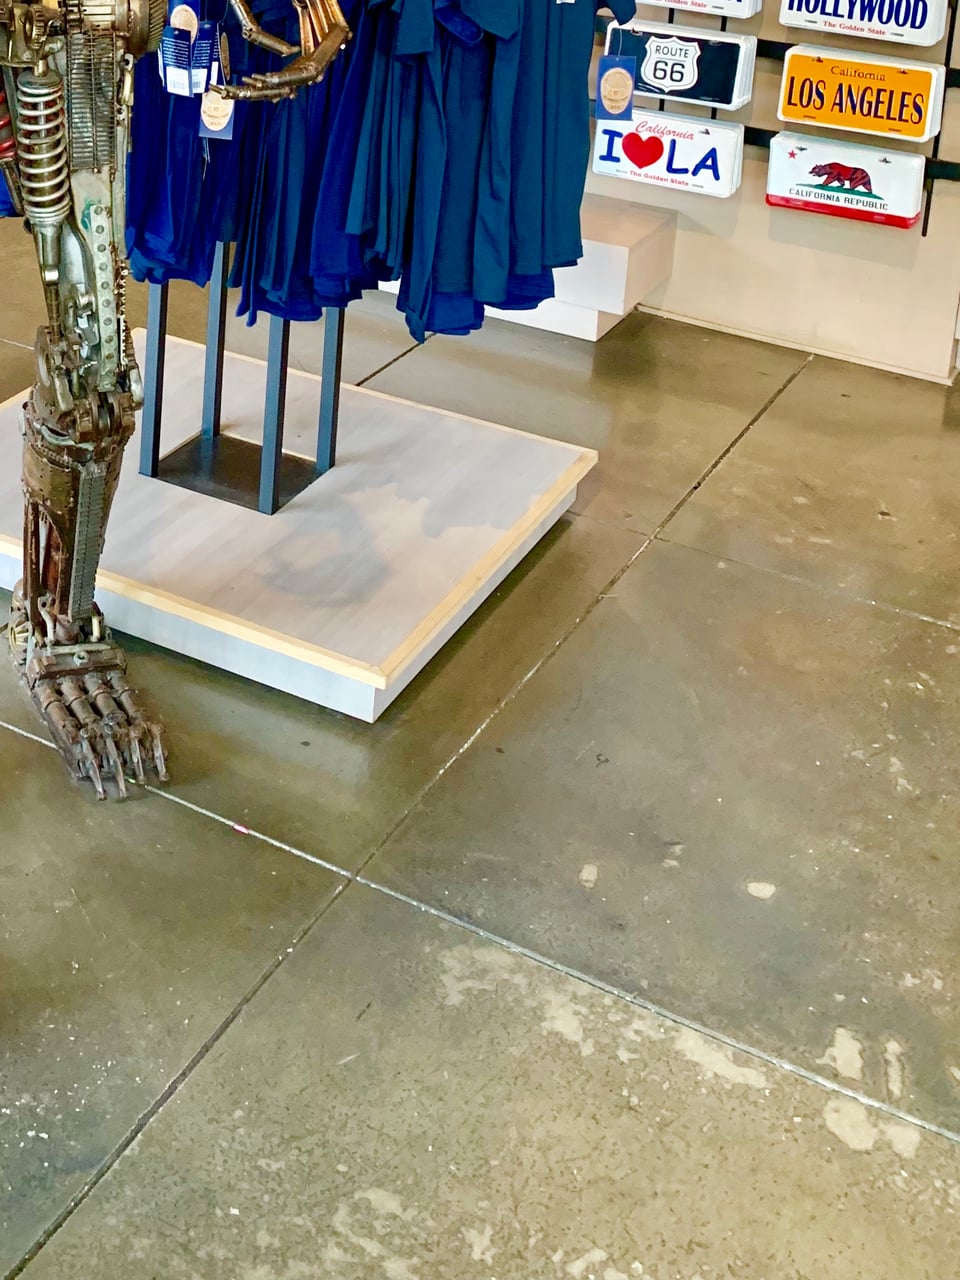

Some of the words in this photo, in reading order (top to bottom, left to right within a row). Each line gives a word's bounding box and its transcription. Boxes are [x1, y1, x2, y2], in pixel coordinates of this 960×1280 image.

[691, 0, 707, 8] State
[823, 20, 837, 28] The
[839, 23, 865, 34] Golden
[867, 26, 886, 36] State
[655, 45, 690, 58] ROUTE
[653, 61, 685, 82] 66
[830, 66, 886, 81] California
[787, 76, 826, 110] LOS
[831, 83, 924, 125] ANGELES
[635, 120, 695, 140] California
[666, 139, 720, 181] LA
[789, 187, 840, 203] CALIFORNIA
[844, 197, 888, 210] REPUBLIC
